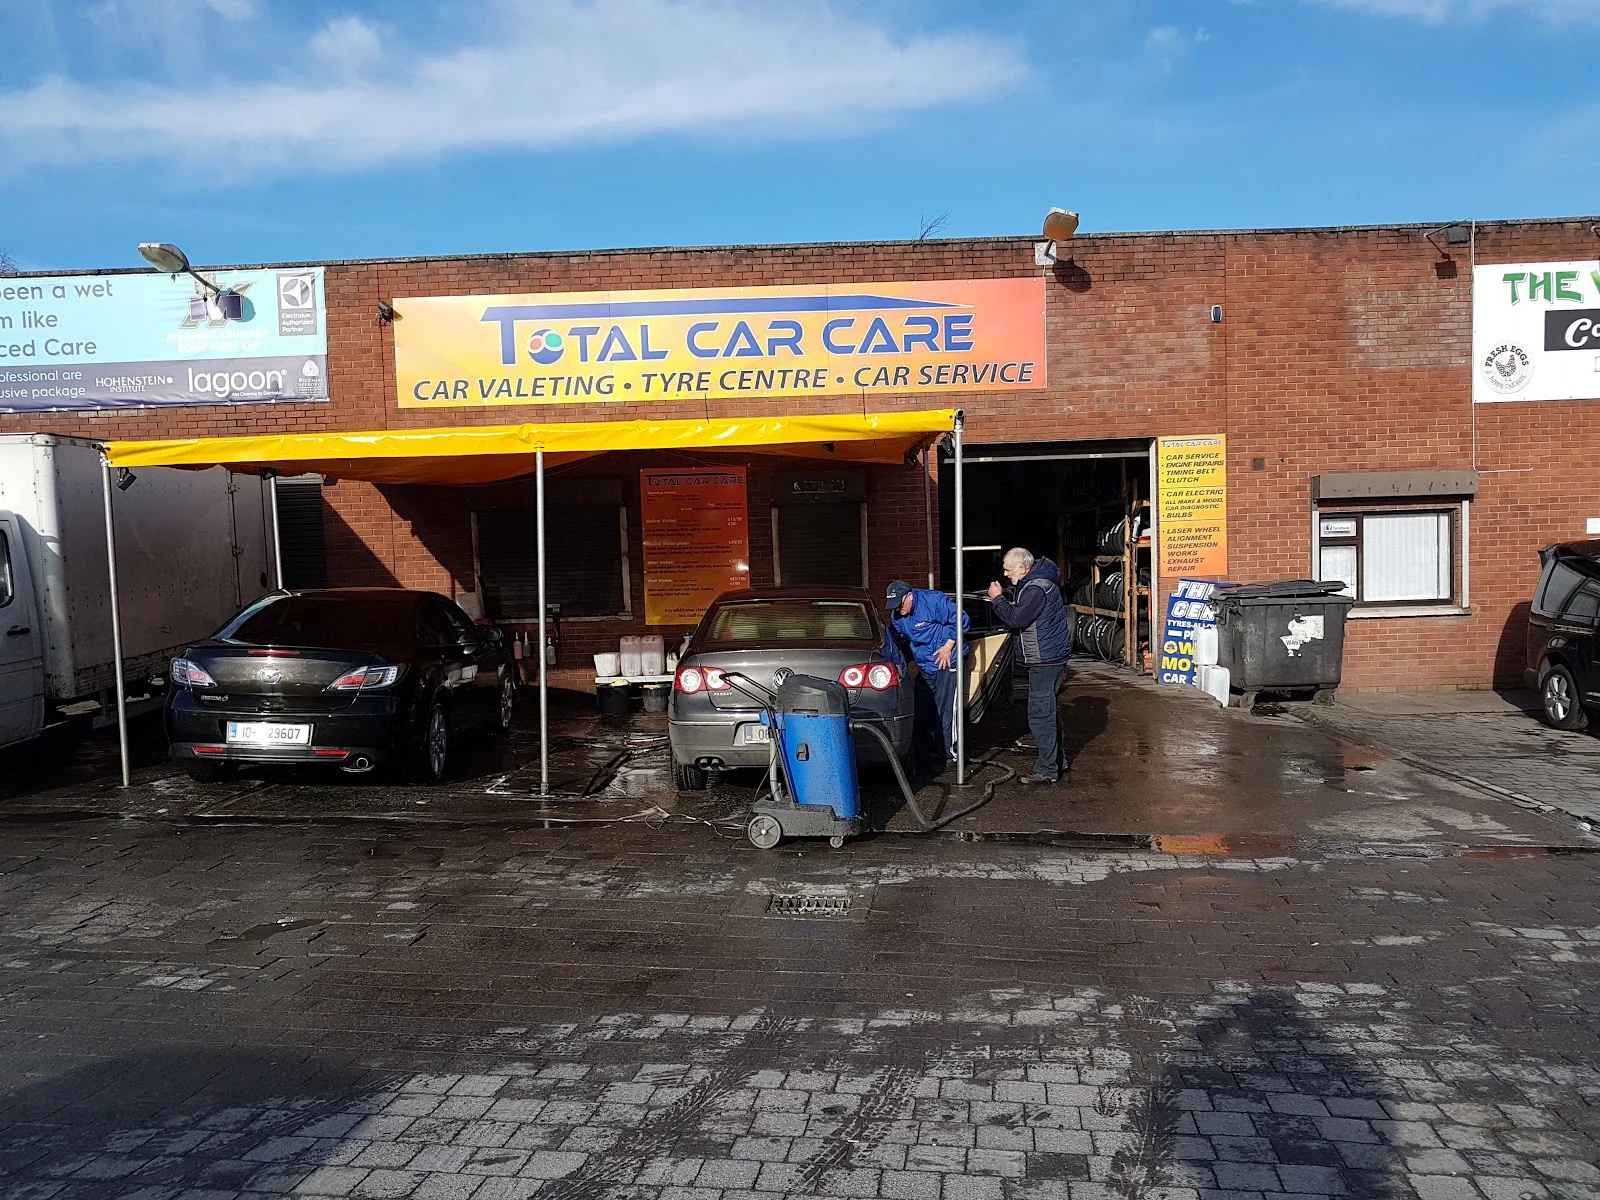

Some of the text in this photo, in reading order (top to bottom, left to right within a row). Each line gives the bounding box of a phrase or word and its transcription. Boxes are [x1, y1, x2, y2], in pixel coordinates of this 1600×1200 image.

[52, 285, 66, 299] a
[74, 279, 113, 298] wet
[1502, 271, 1583, 304] THE
[22, 310, 58, 329] like
[481, 303, 976, 365] TOTAL CAR CARE
[44, 338, 97, 356] Care
[1485, 344, 1529, 367] FRESH EGGS
[62, 371, 82, 380] are
[95, 375, 166, 387] HOHENSTEIN
[413, 361, 1035, 401] CAR VALETING TYRE CENTRE CAR SERVICE
[32, 386, 86, 399] package
[109, 385, 147, 393] INSTITUTE
[1185, 452, 1220, 460] SERVICE
[685, 477, 710, 485] CAR
[713, 476, 744, 485] CARE
[1166, 476, 1200, 484] CLUTCH
[1185, 489, 1224, 497] ELECTRIC
[1166, 511, 1193, 519] BULBS
[1166, 527, 1192, 535] LASER
[1166, 534, 1213, 542] ALIGNMENT
[1167, 541, 1219, 549] SUSPENSION
[1167, 557, 1205, 565] EXHAUST
[1161, 656, 1198, 672] MO
[1163, 672, 1187, 685] CAR
